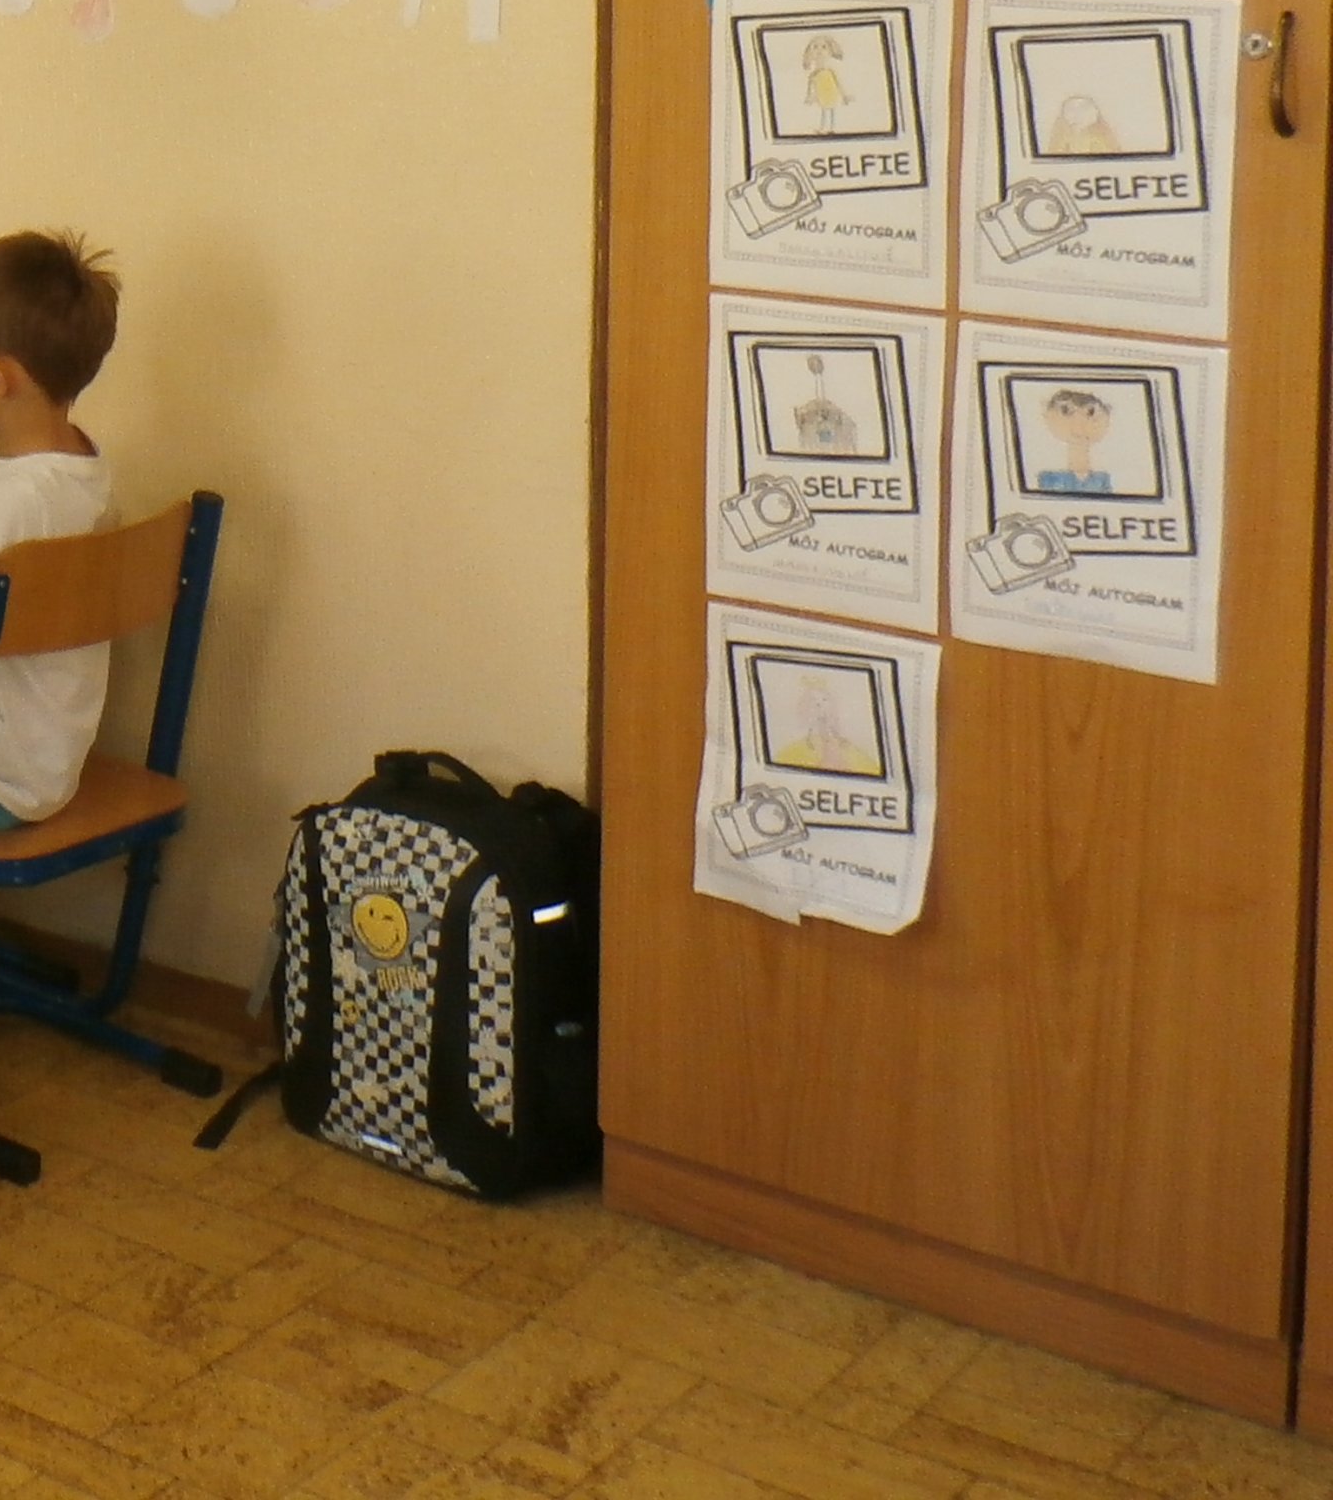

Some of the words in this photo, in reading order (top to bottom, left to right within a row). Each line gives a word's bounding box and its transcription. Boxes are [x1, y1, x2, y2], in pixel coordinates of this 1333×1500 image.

[809, 151, 912, 180] SELFIE
[1074, 174, 1190, 201] SELFIE
[833, 223, 918, 242] AUTOGRAM
[1099, 247, 1197, 269] AUTOGRAM
[802, 474, 903, 502] SELFIE
[1062, 514, 1178, 543] SELFIE
[826, 542, 910, 567] AUTOGRAM
[1088, 585, 1185, 612] AUTOGRAM
[797, 788, 899, 821] SELFIE
[819, 856, 898, 886] AUTOGRAM
